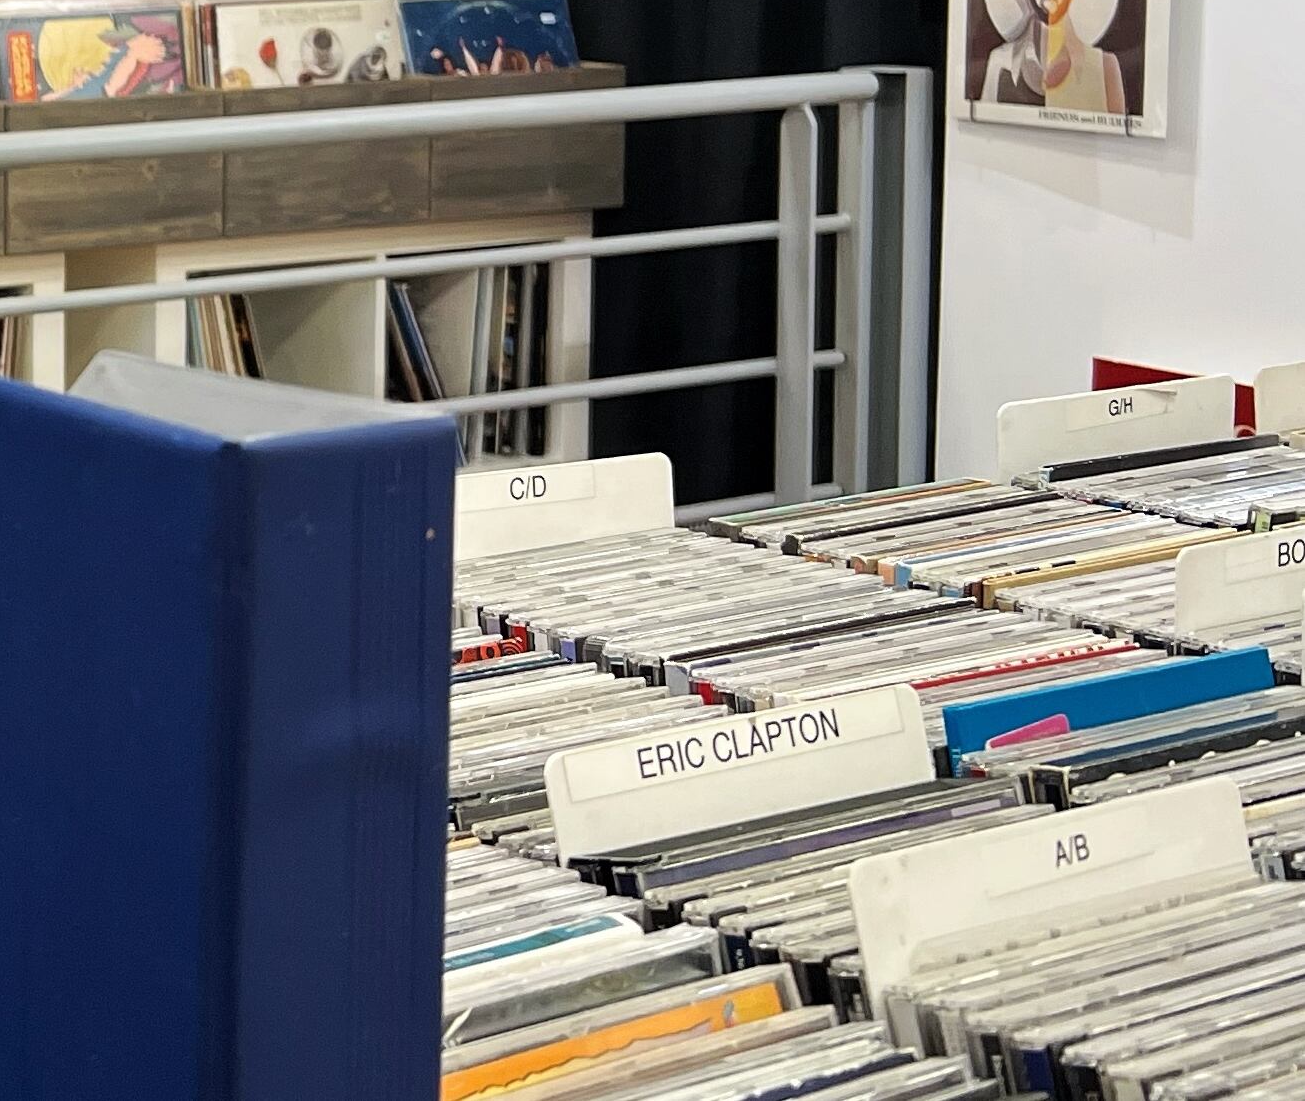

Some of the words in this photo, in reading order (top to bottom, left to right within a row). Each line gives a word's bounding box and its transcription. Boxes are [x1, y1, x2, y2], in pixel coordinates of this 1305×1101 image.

[1108, 396, 1133, 416] G/H
[509, 474, 547, 501] C/D
[636, 736, 707, 780] ERIC
[711, 707, 841, 765] CLAPTON
[1054, 833, 1091, 869] A/B
